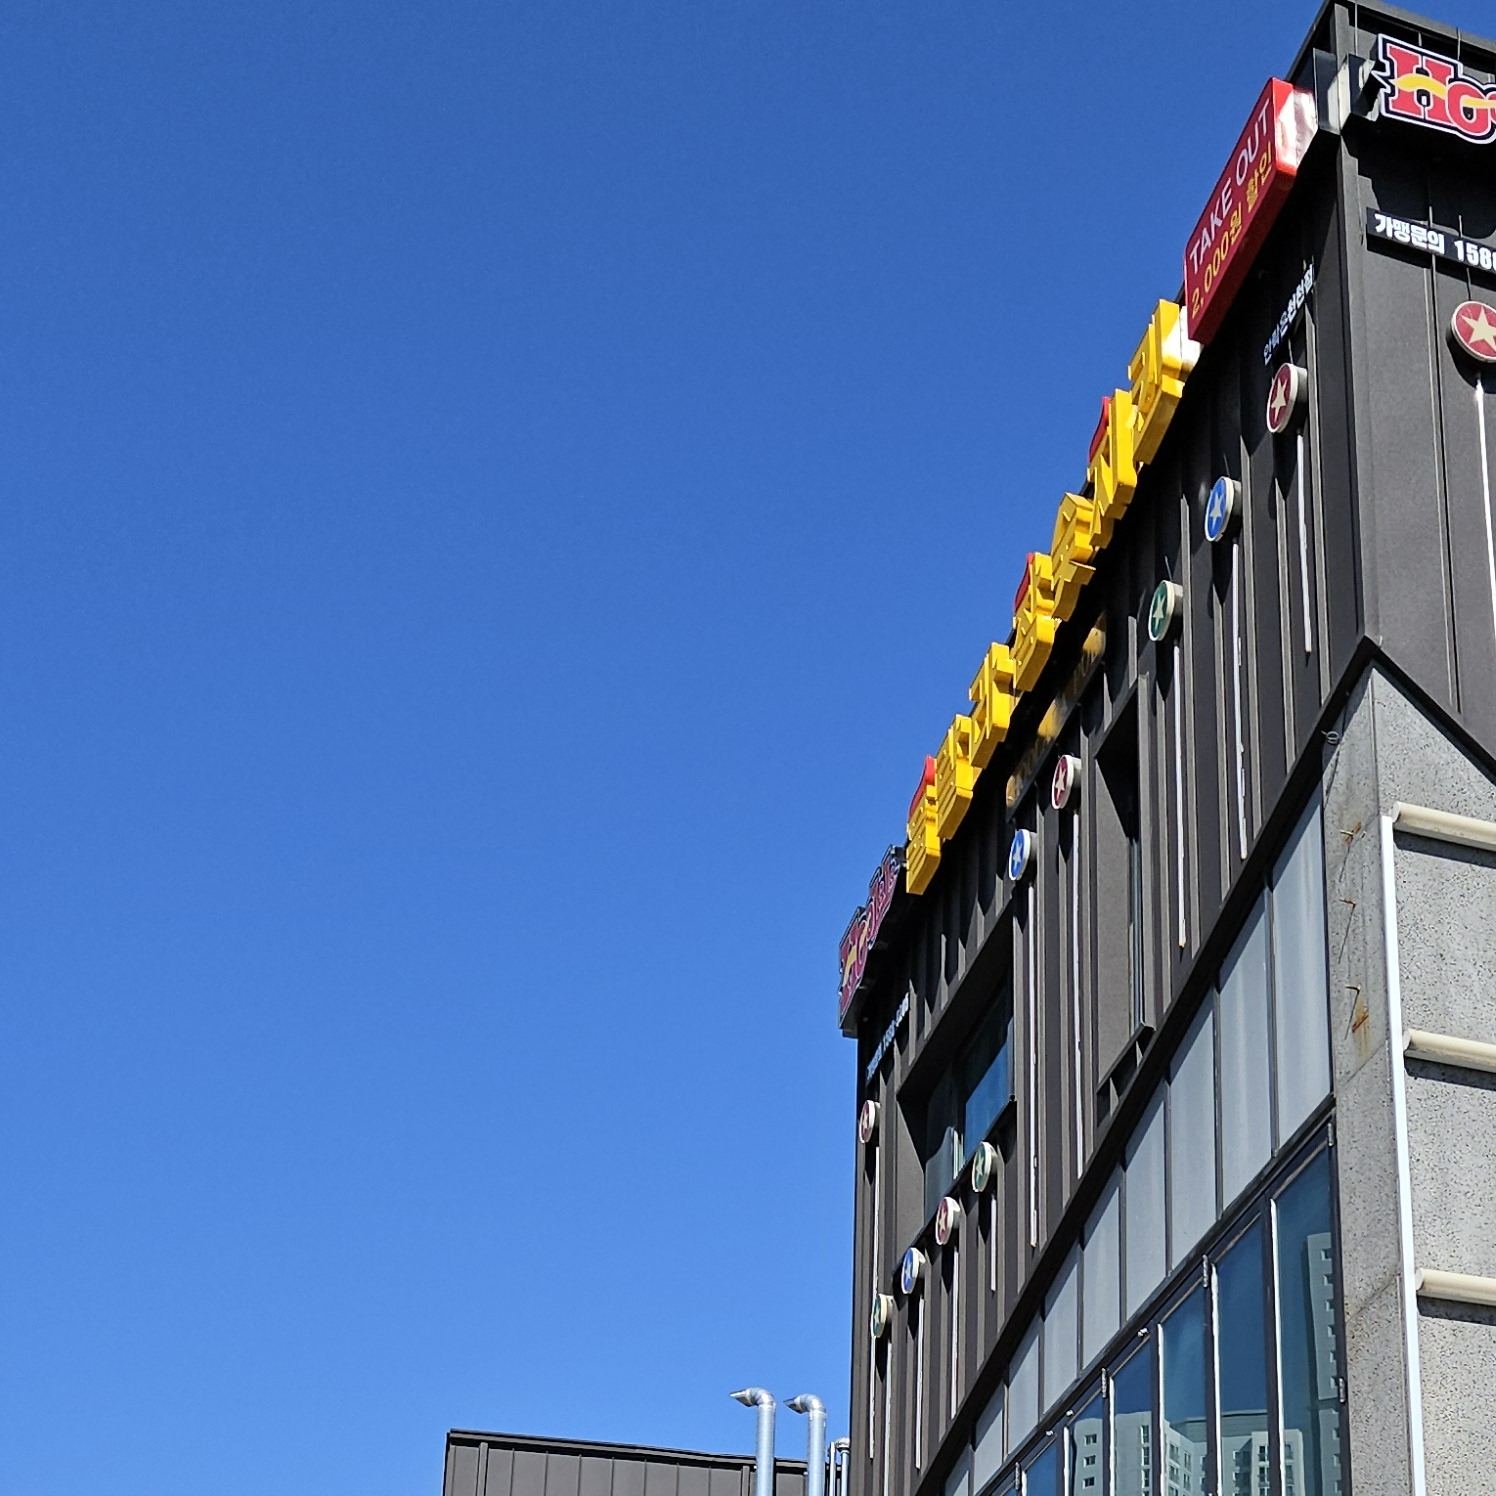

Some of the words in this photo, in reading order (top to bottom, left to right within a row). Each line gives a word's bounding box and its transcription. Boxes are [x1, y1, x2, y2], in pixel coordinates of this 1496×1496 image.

[1190, 177, 1233, 275] TAKE
[1236, 98, 1270, 187] OUT
[1191, 202, 1242, 319] 2,000원
[1246, 141, 1271, 212] 할인
[1374, 213, 1445, 255] 가맹문의
